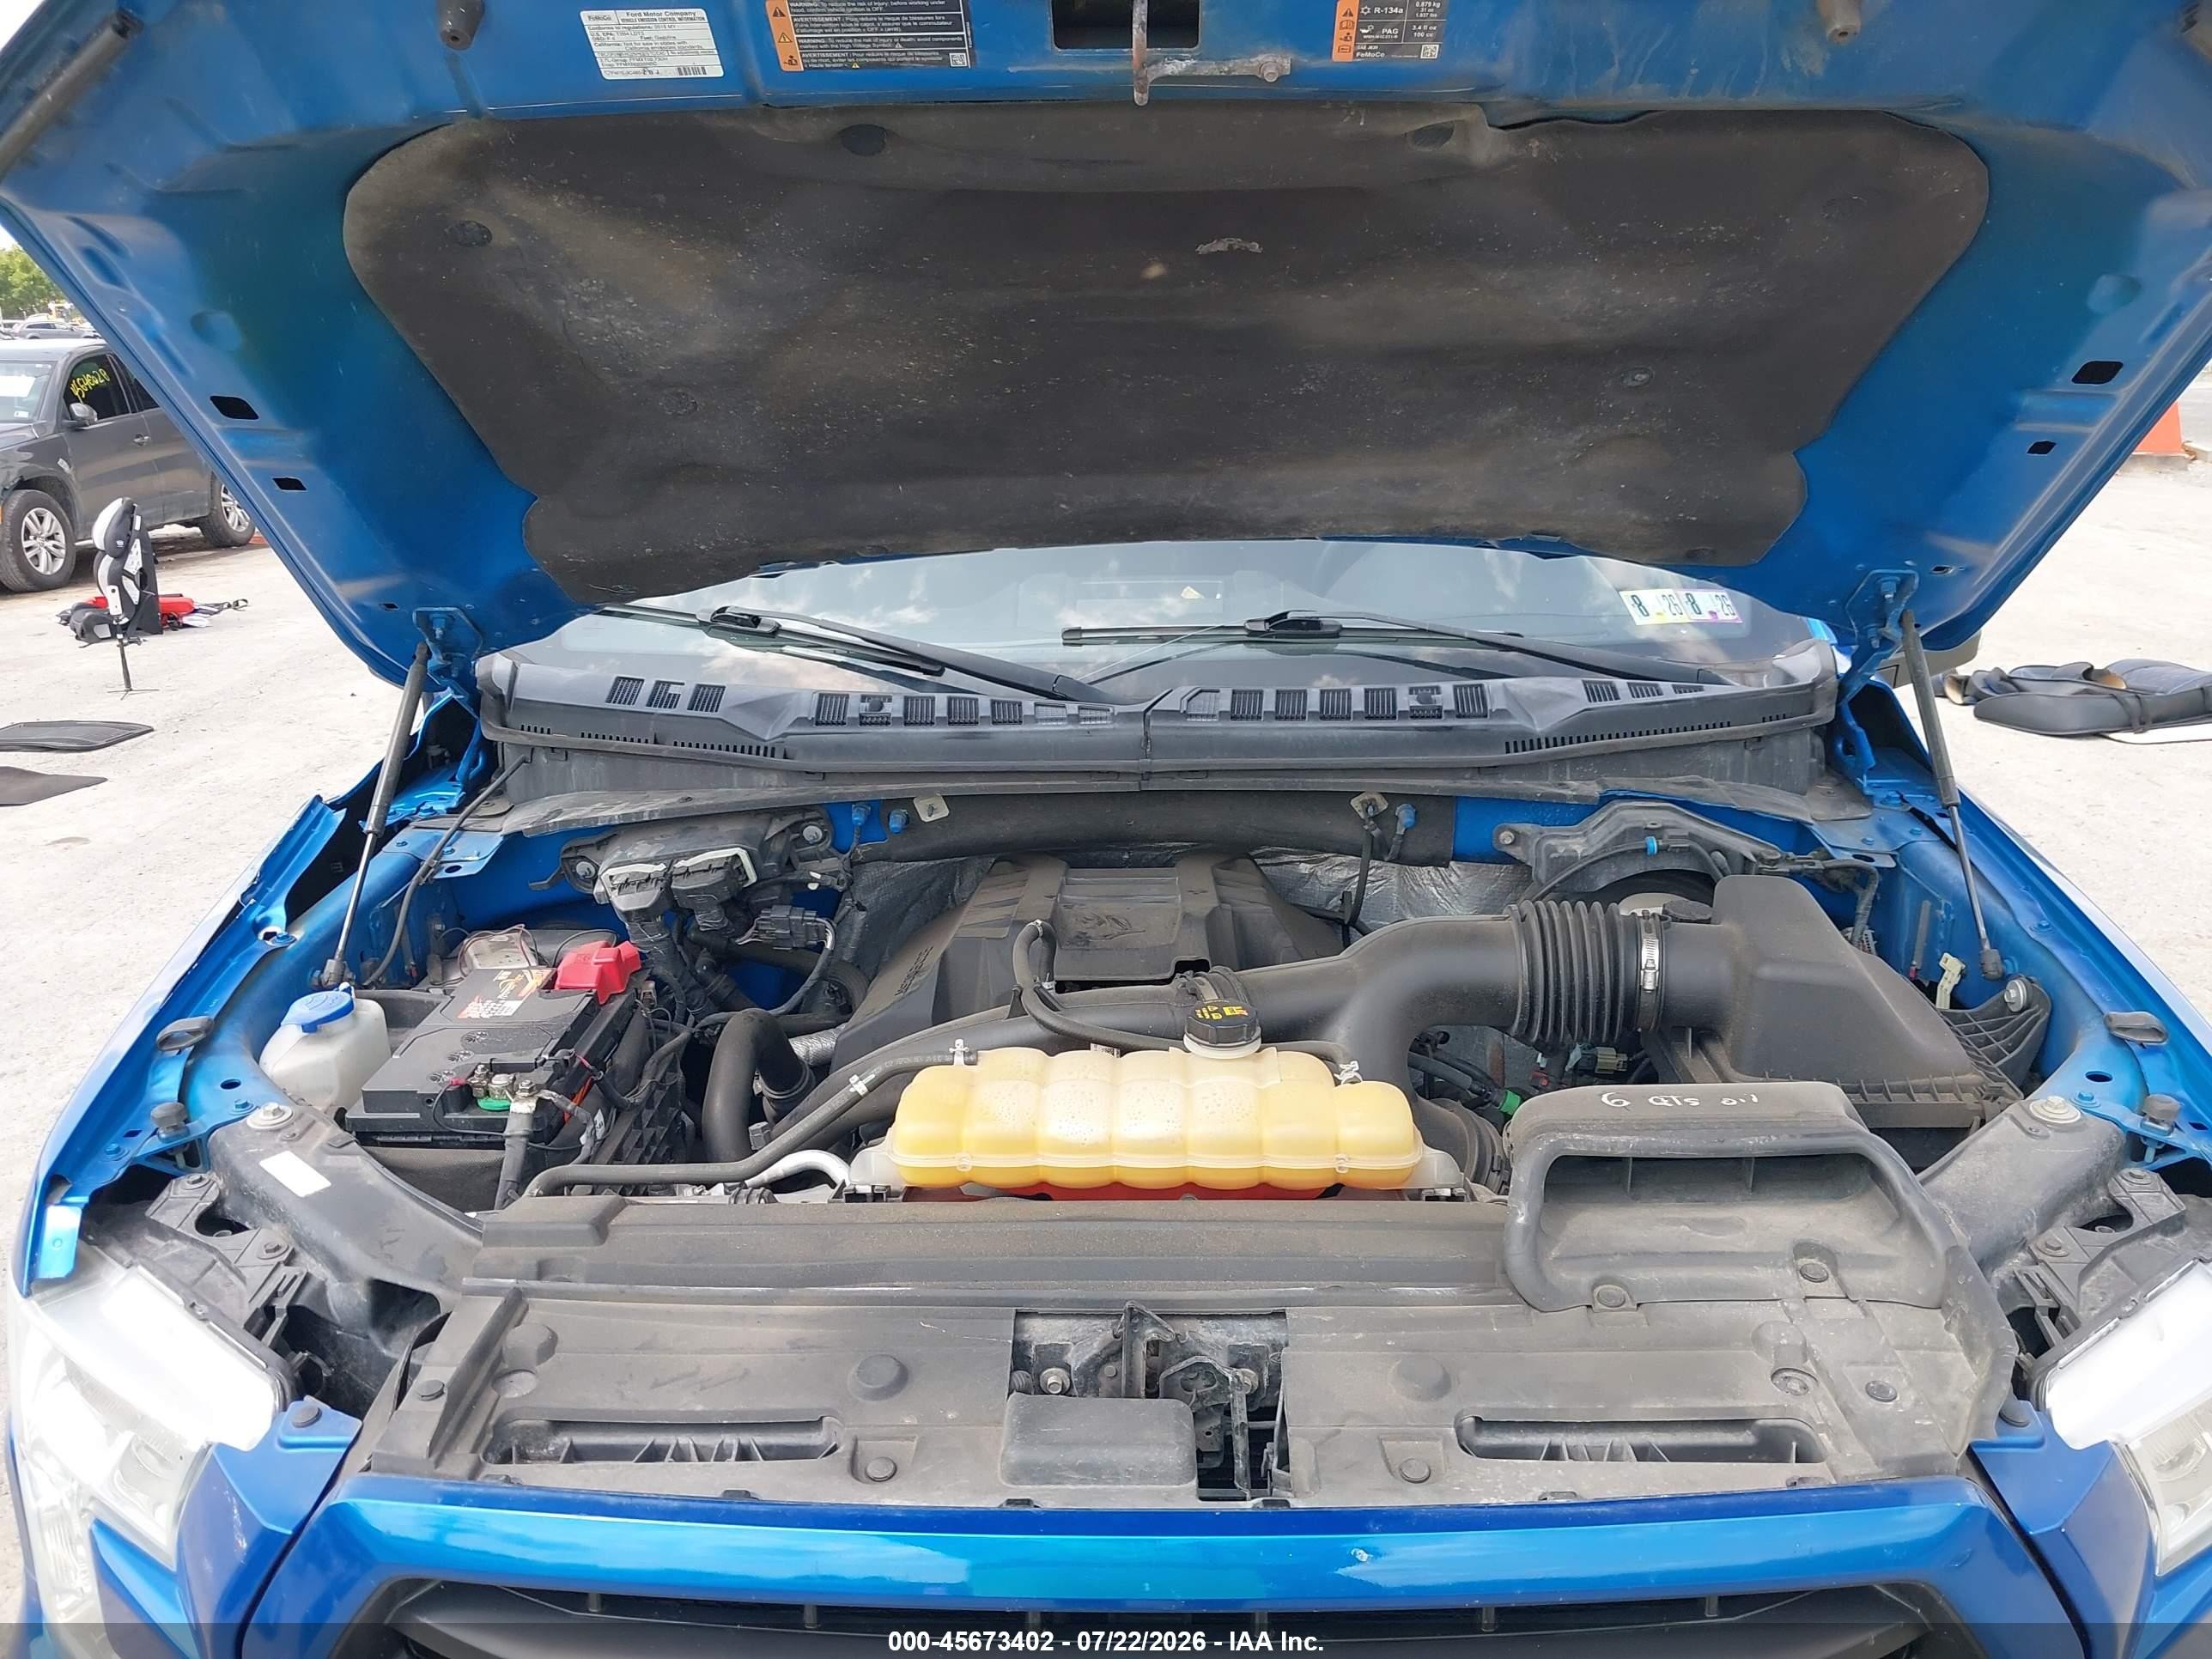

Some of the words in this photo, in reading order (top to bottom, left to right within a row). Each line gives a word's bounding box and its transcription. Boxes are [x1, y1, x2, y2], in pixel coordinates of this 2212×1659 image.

[1632, 594, 1650, 617] 8
[1686, 592, 1702, 615] 8
[1601, 1091, 1631, 1108] 6
